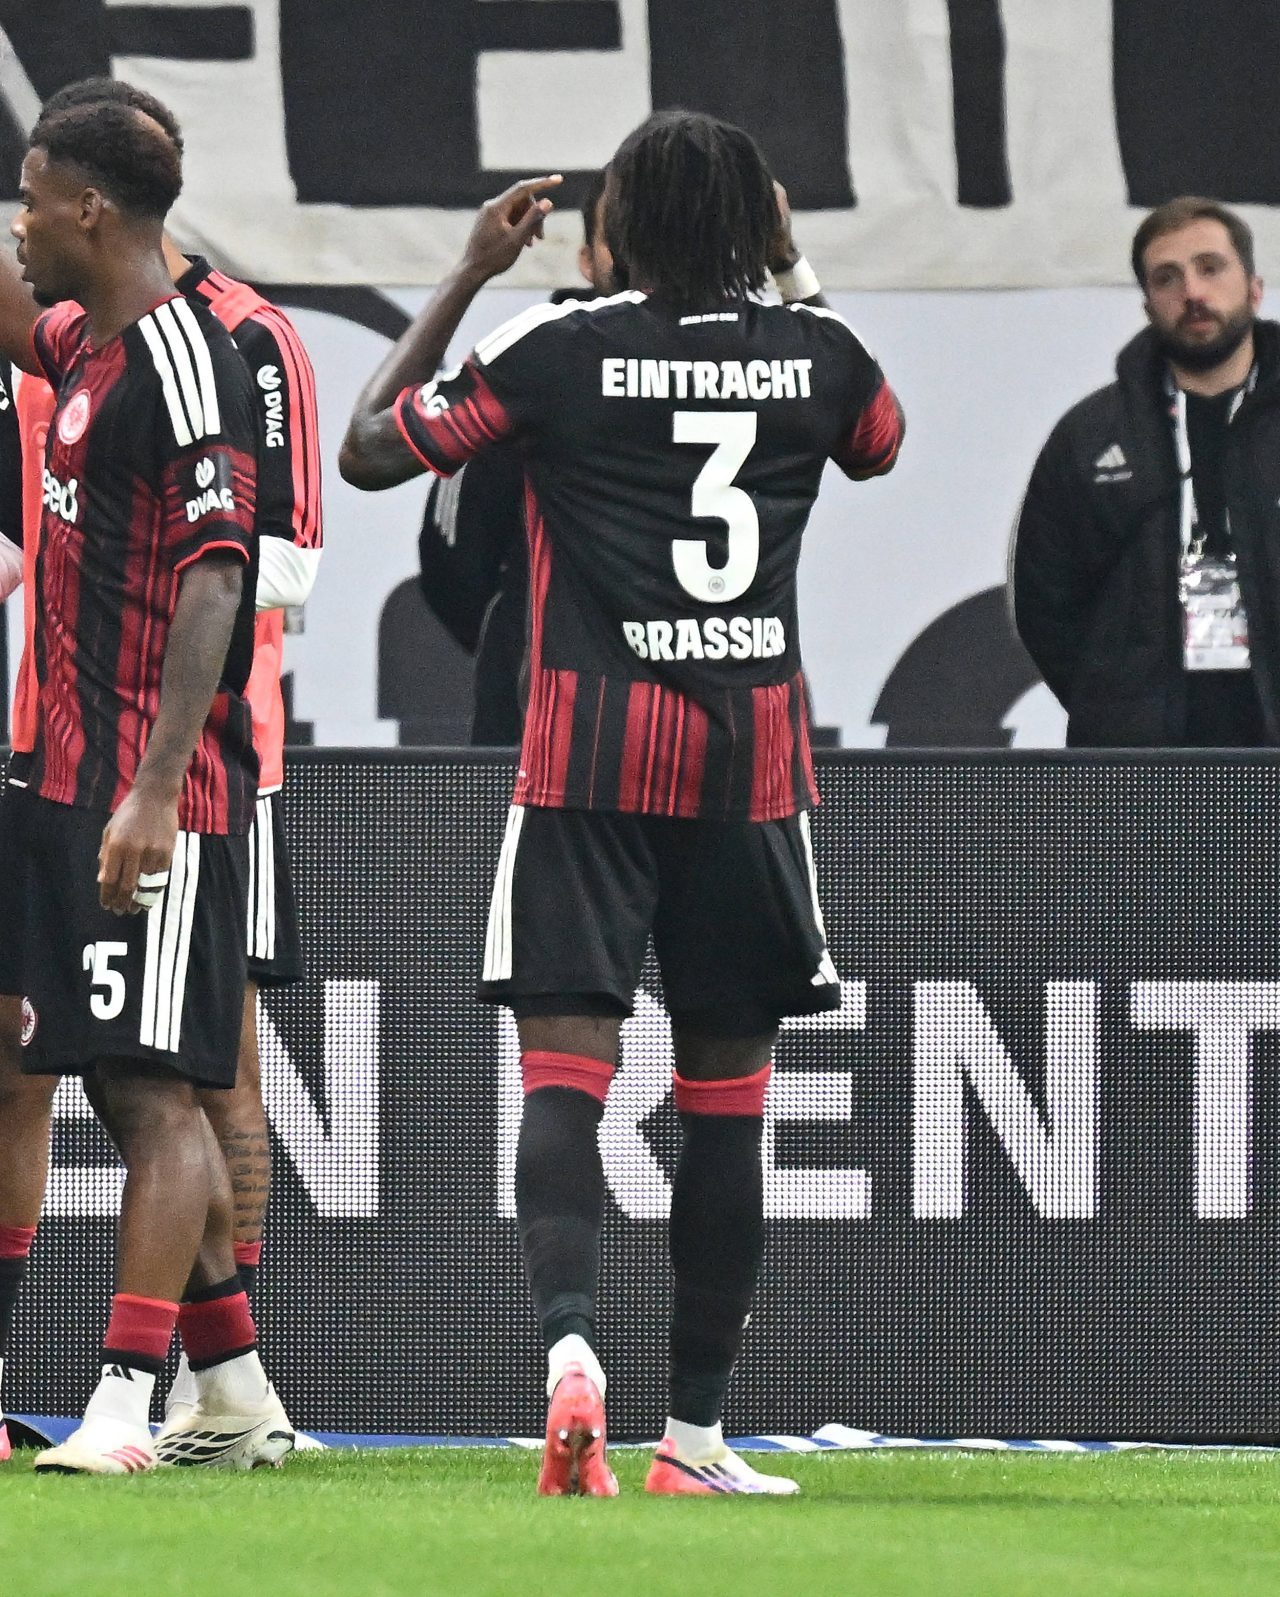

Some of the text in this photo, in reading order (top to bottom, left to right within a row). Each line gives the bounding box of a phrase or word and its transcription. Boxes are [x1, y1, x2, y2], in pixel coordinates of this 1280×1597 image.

[601, 358, 812, 399] EINTRACHT
[264, 390, 285, 448] DVAG
[186, 488, 235, 523] DVAG
[672, 411, 759, 603] 3
